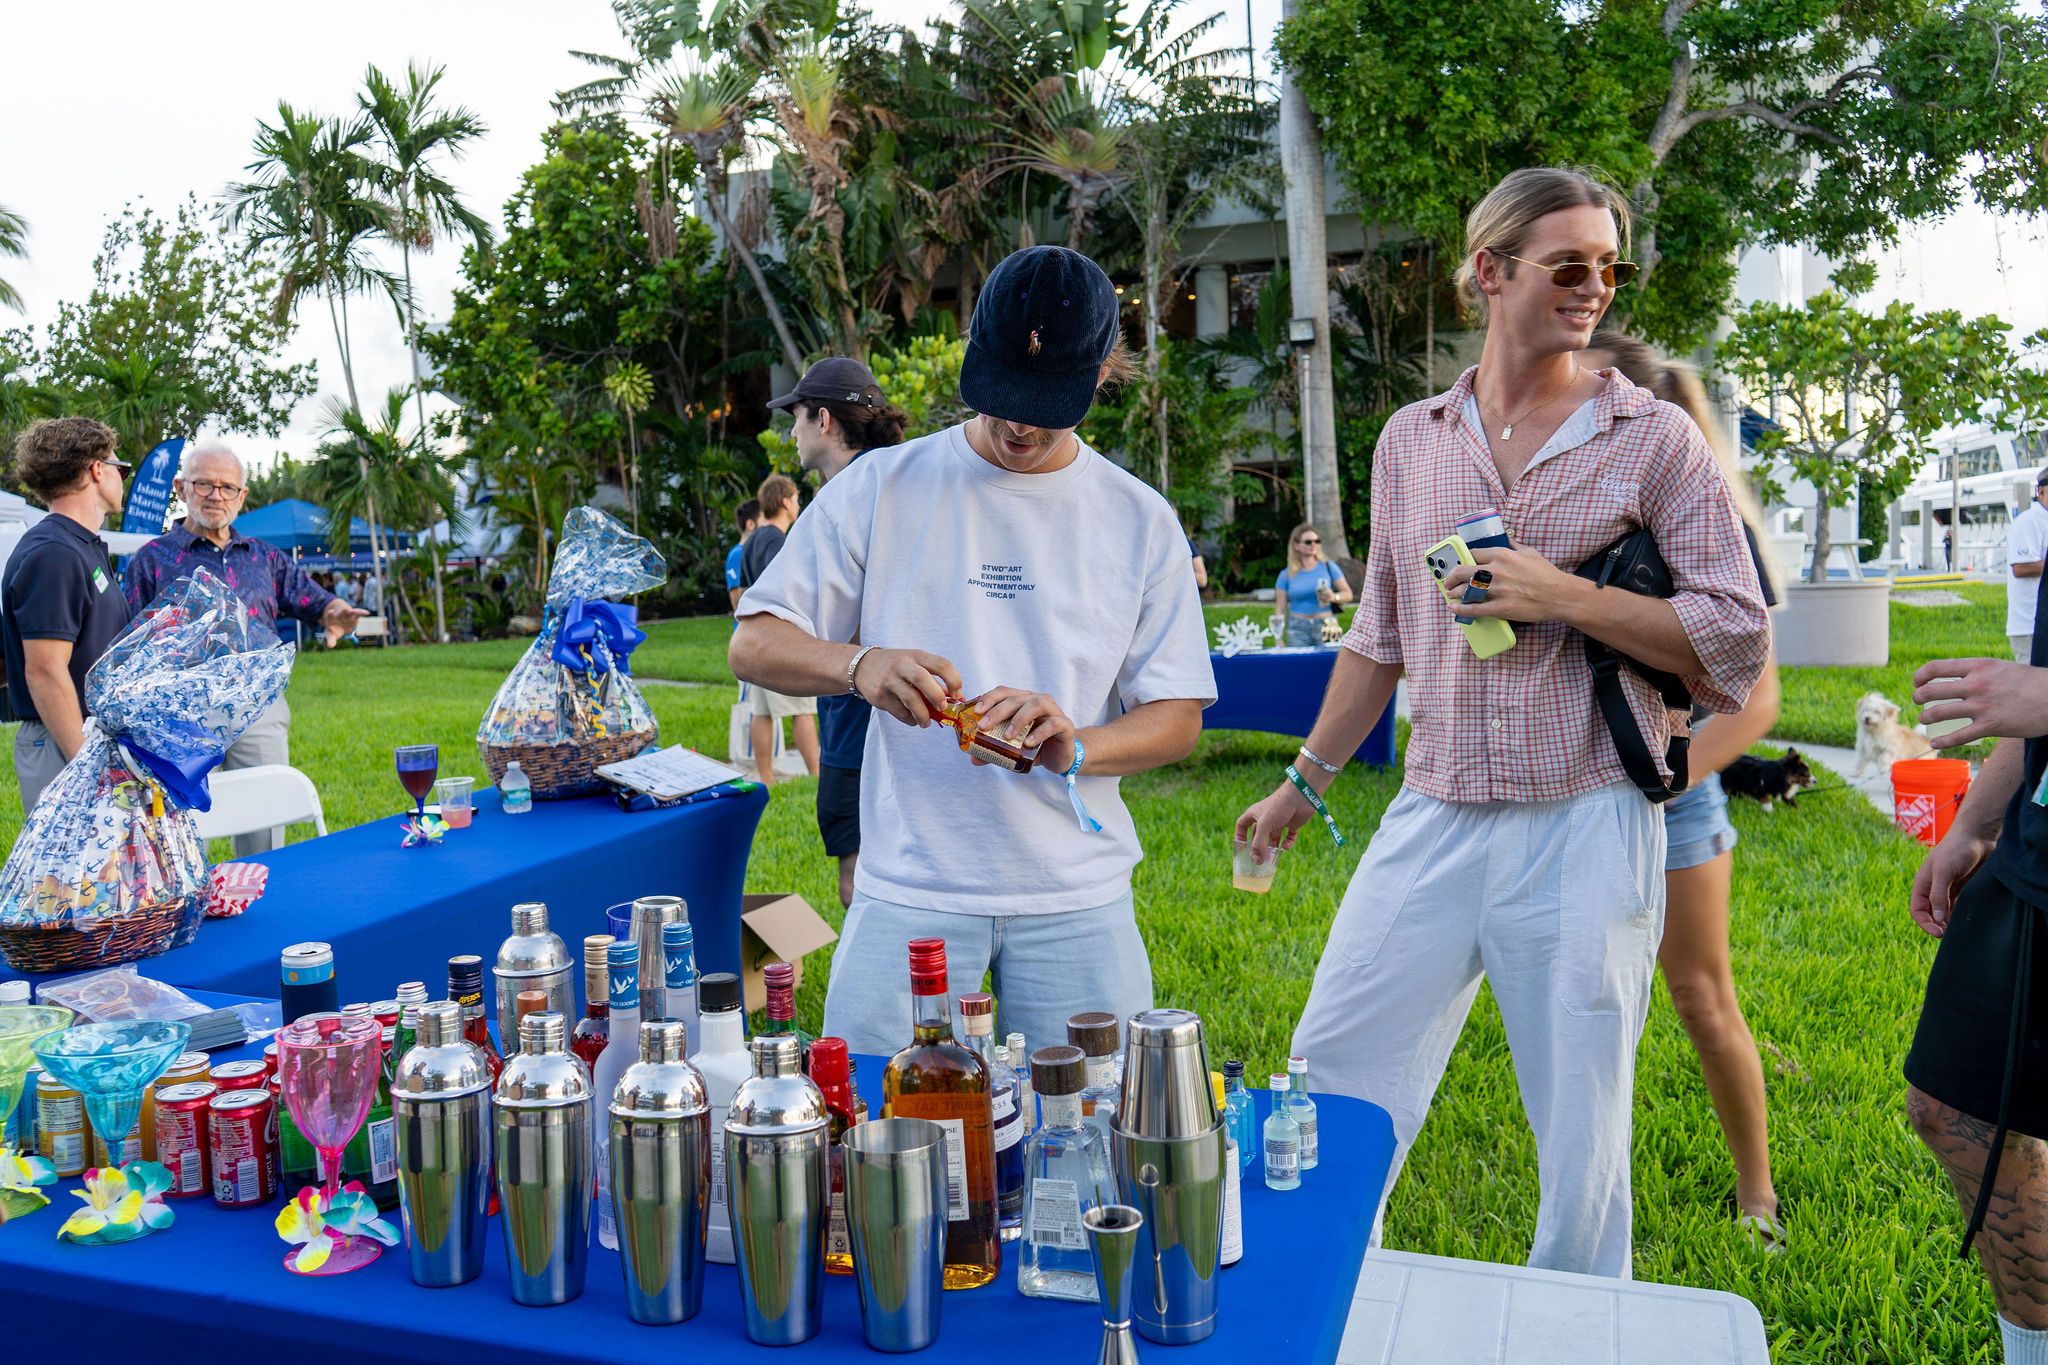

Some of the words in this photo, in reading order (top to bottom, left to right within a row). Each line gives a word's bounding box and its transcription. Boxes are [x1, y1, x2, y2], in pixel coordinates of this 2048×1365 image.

[137, 482, 167, 500] Island
[131, 493, 166, 512] Marine
[128, 504, 163, 523] Electric
[967, 578, 1018, 591] APPOINTMENT
[981, 573, 1022, 581] EXHIBITION
[986, 591, 1008, 599] CIRCA
[1301, 786, 1323, 810] TRITON
[459, 992, 480, 1004] APEROL
[992, 1100, 1008, 1110] ESS
[266, 1152, 275, 1195] RECYCLE
